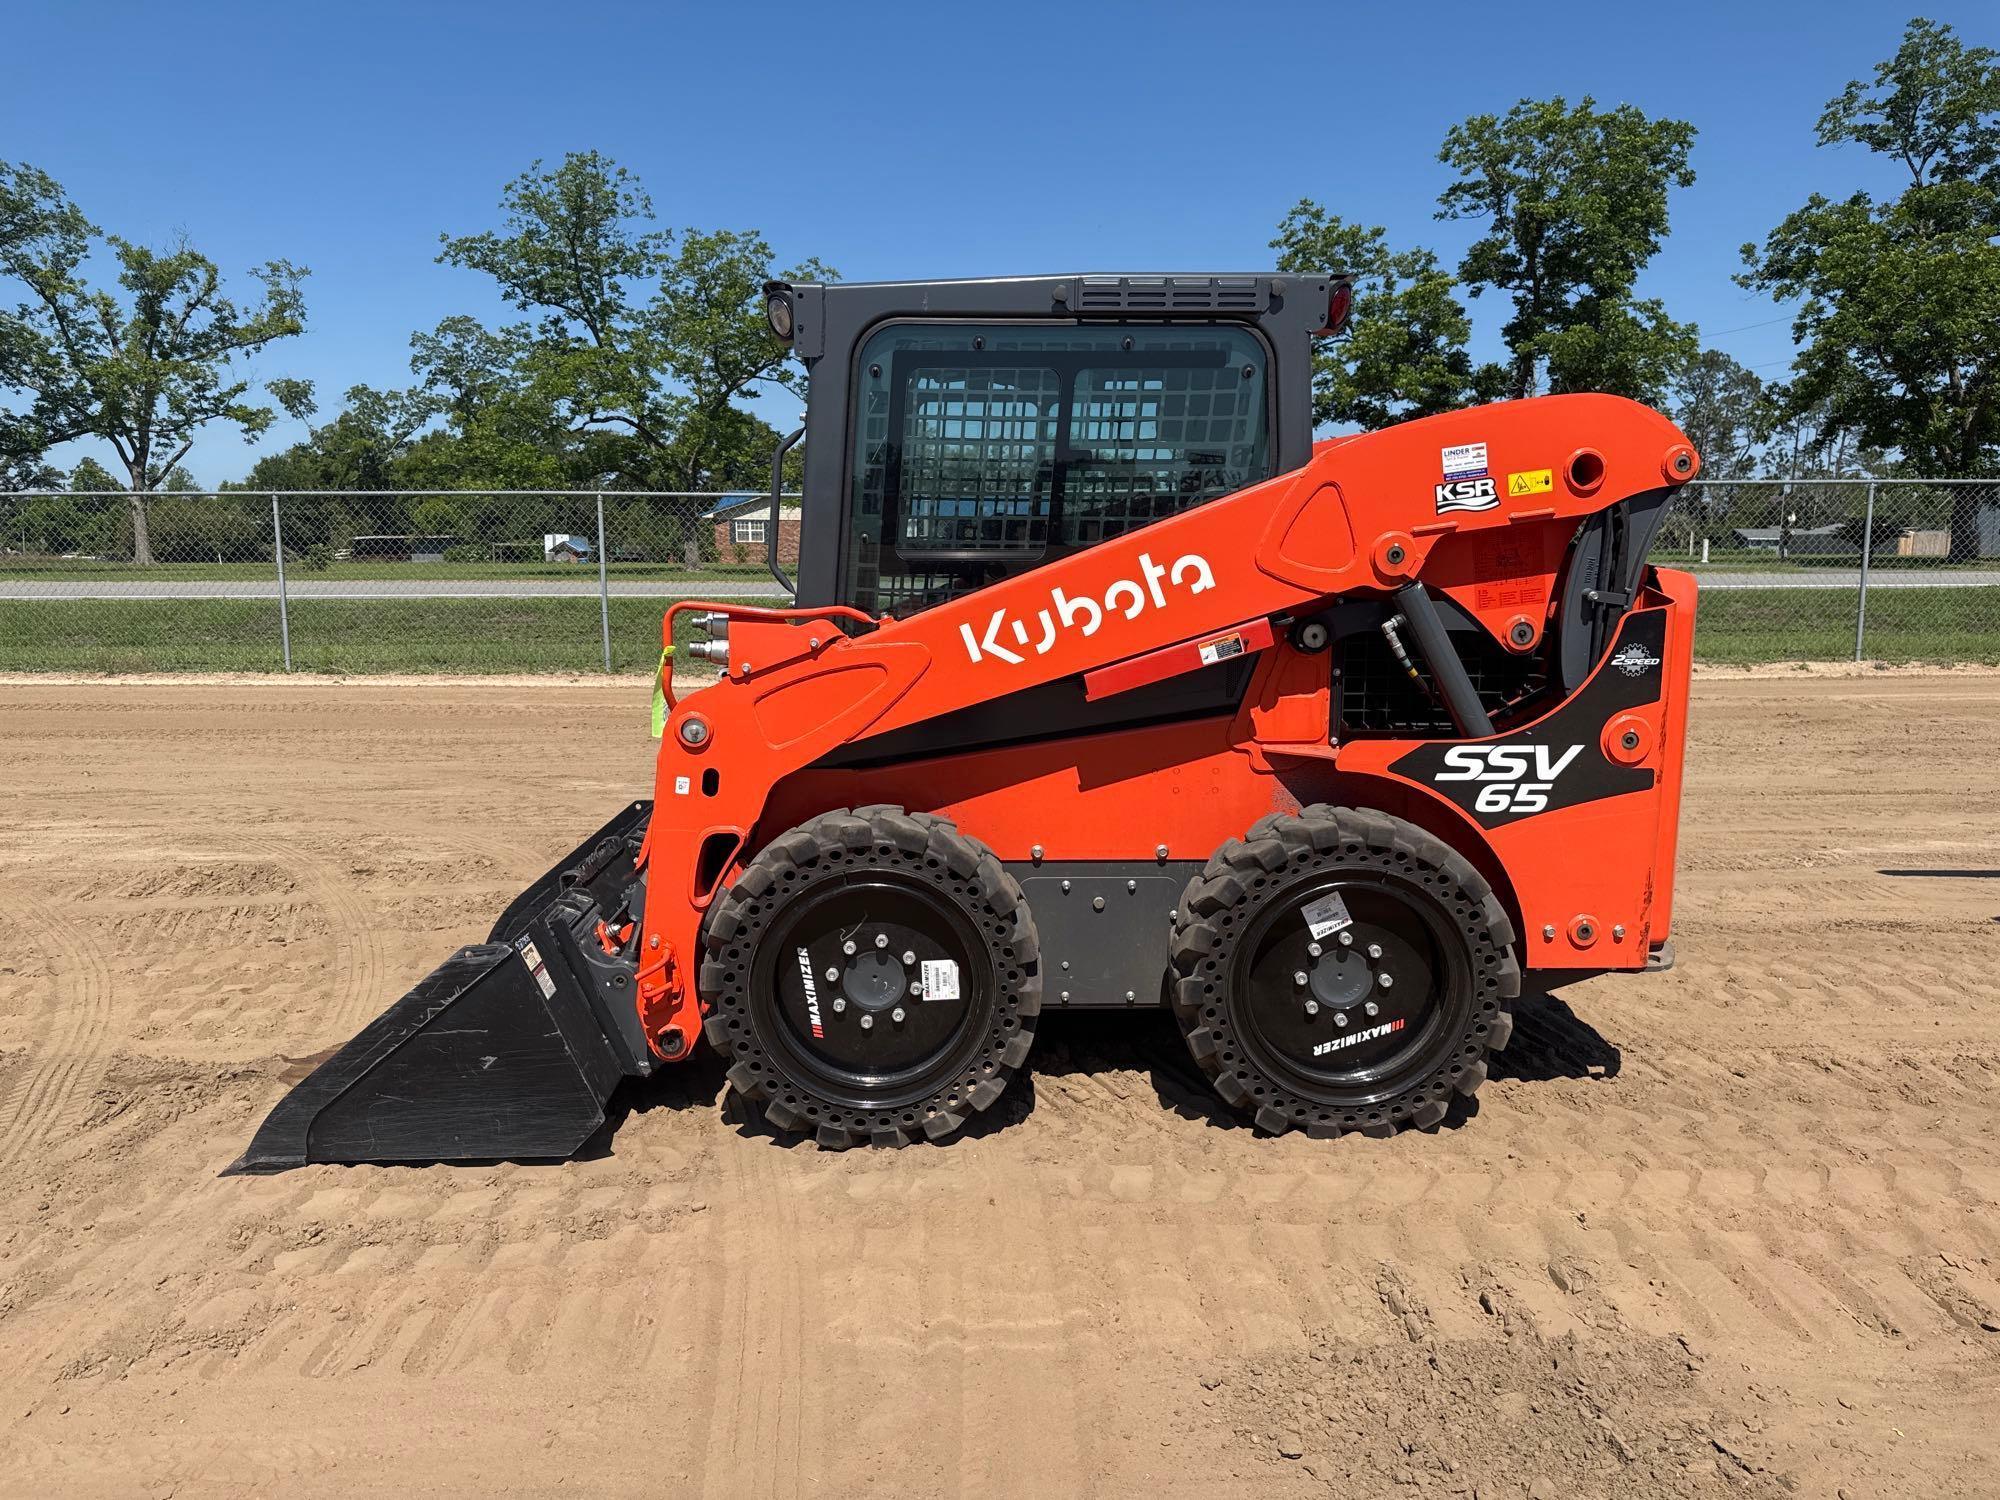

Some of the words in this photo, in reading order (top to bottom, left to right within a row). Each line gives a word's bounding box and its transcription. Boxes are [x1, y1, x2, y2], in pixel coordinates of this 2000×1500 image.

[1443, 447, 1470, 457] LINDER
[1436, 479, 1495, 502] KSR
[959, 553, 1215, 664] Kubota
[1434, 745, 1586, 781] SSV
[1474, 783, 1553, 813] 65
[797, 947, 822, 1025] MAXIMIZER
[1313, 1022, 1393, 1056] MAXIMIZER
